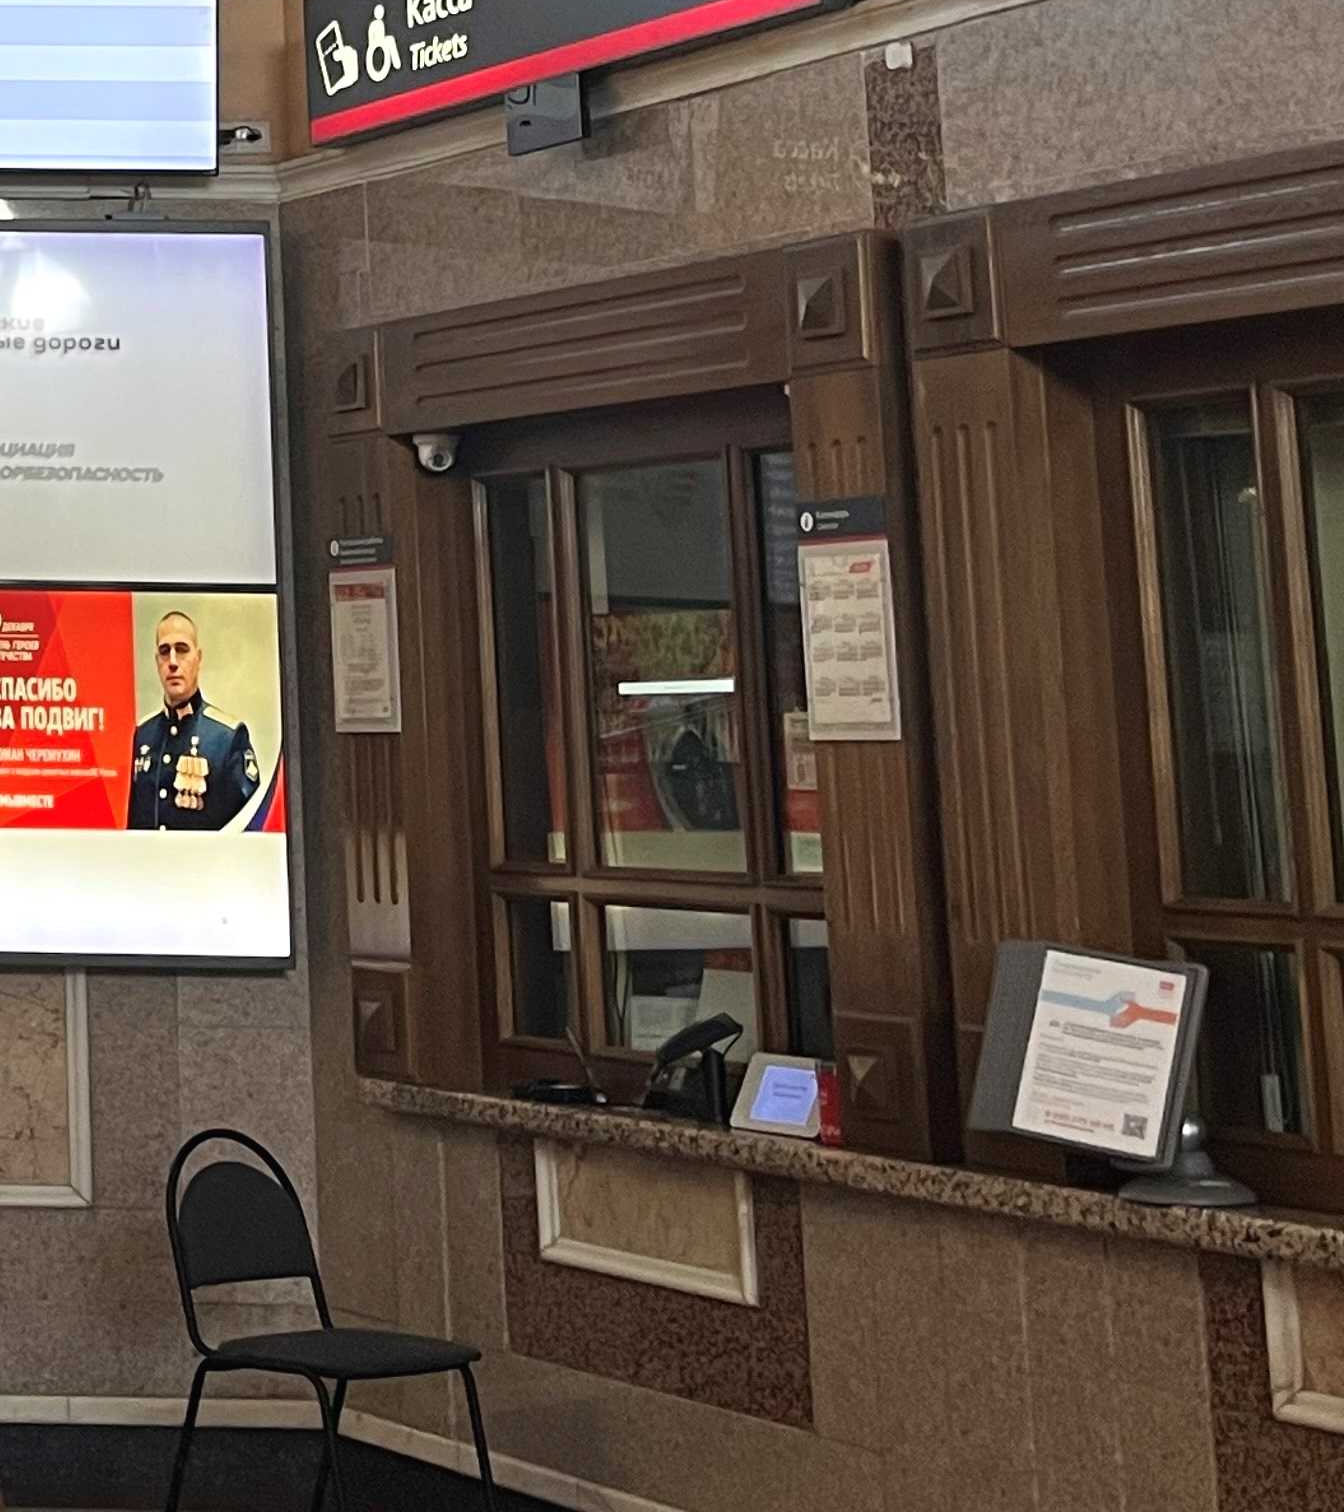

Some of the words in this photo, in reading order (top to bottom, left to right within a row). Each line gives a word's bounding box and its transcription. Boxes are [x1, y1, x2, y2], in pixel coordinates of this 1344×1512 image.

[409, 31, 468, 72] Tickets
[33, 336, 121, 355] дороги
[20, 706, 104, 736] ПОДВИГ!
